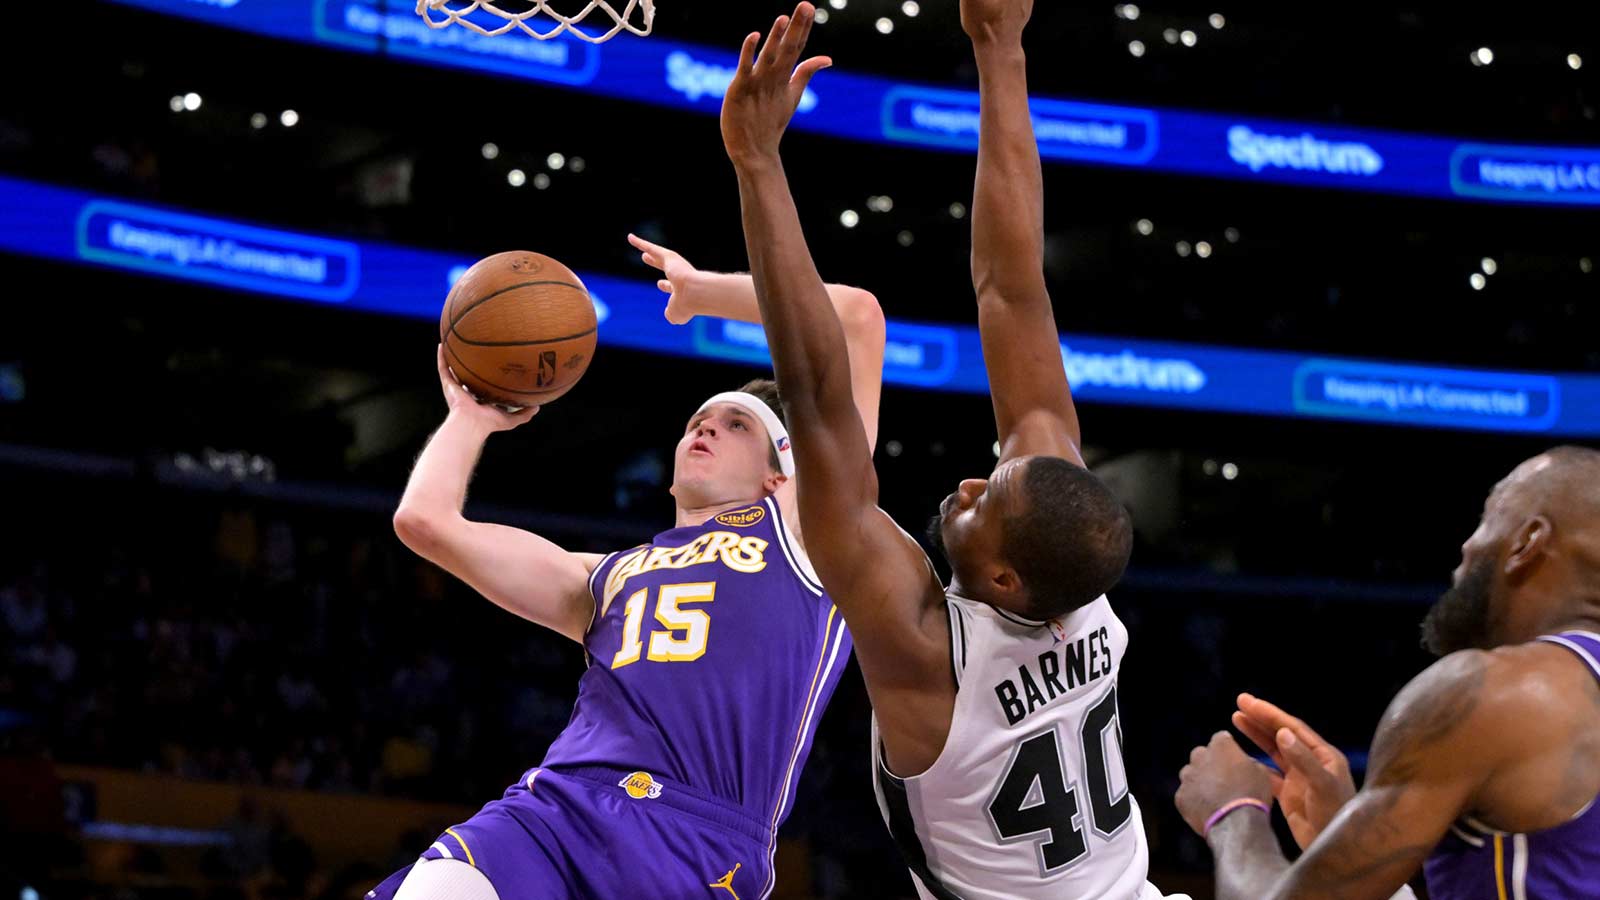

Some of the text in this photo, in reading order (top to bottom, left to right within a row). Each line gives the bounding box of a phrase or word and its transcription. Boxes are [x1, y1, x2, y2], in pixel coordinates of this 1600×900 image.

[1227, 125, 1383, 176] Spectrum
[719, 510, 762, 521] bibigo
[601, 530, 769, 619] LAKERS
[611, 581, 716, 670] 15
[994, 626, 1112, 726] BARNES
[982, 681, 1132, 879] 40
